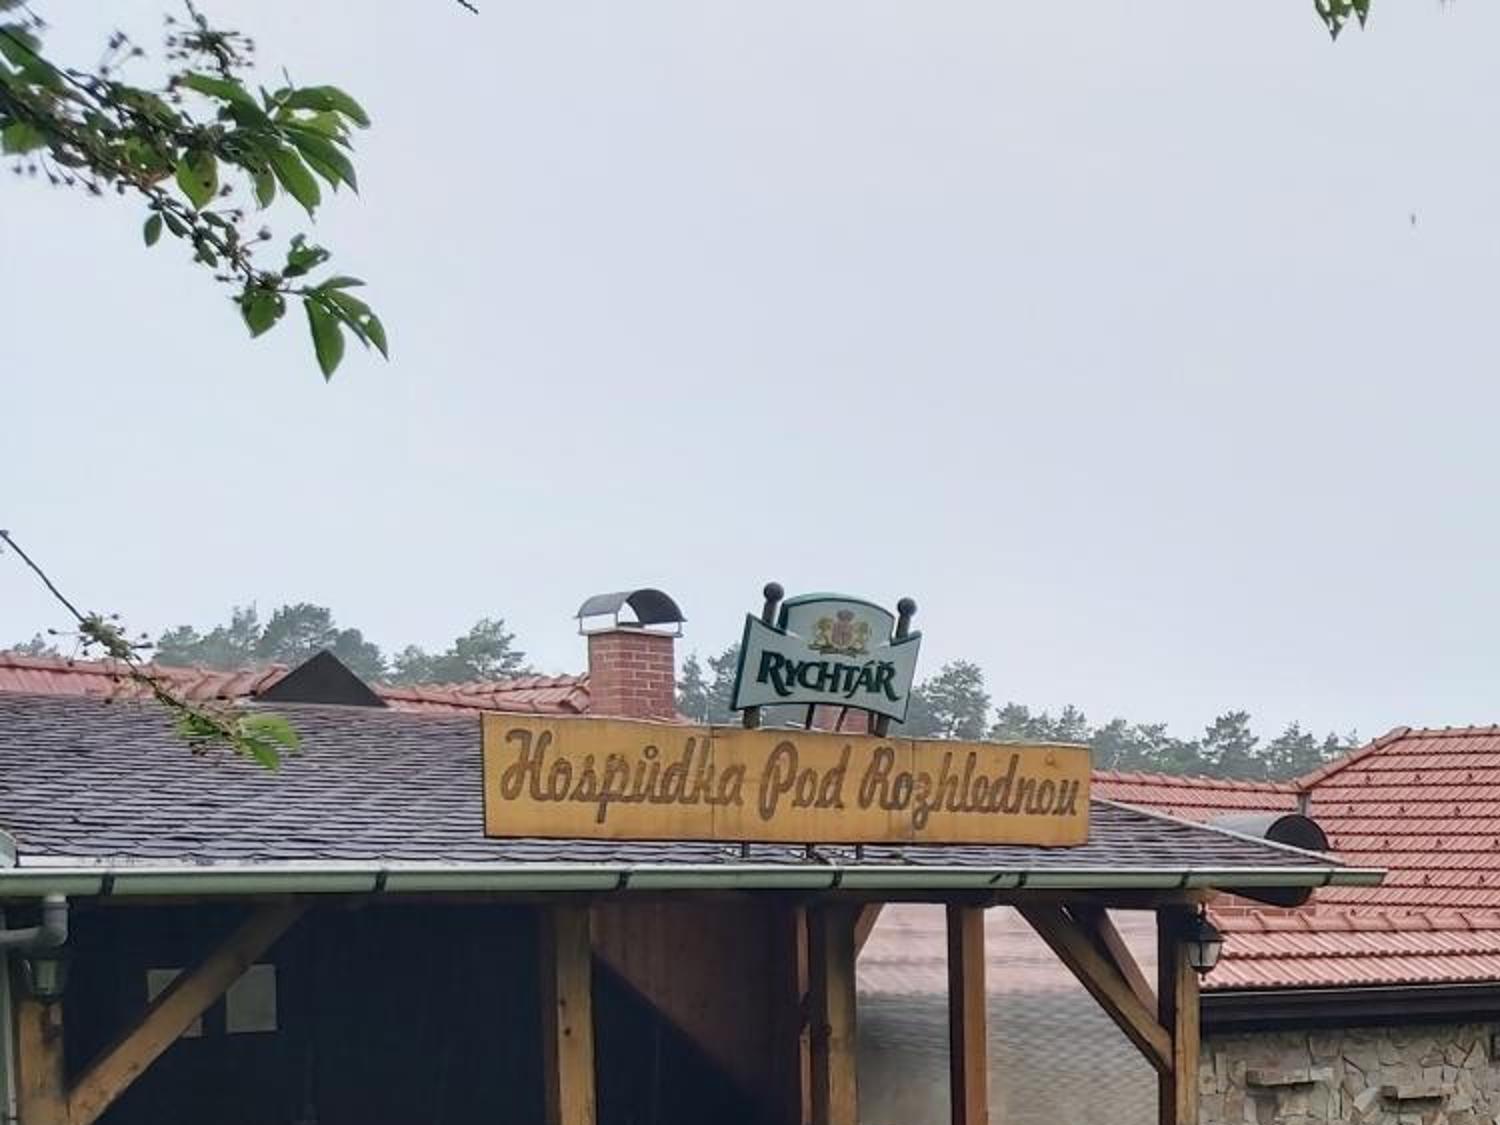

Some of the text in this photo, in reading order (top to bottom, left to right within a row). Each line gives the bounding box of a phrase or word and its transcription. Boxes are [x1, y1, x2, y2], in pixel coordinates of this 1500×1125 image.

[756, 650, 900, 702] RYCHTÁŘ
[500, 728, 1080, 831] Hospůdka Pod Rozhlednou
